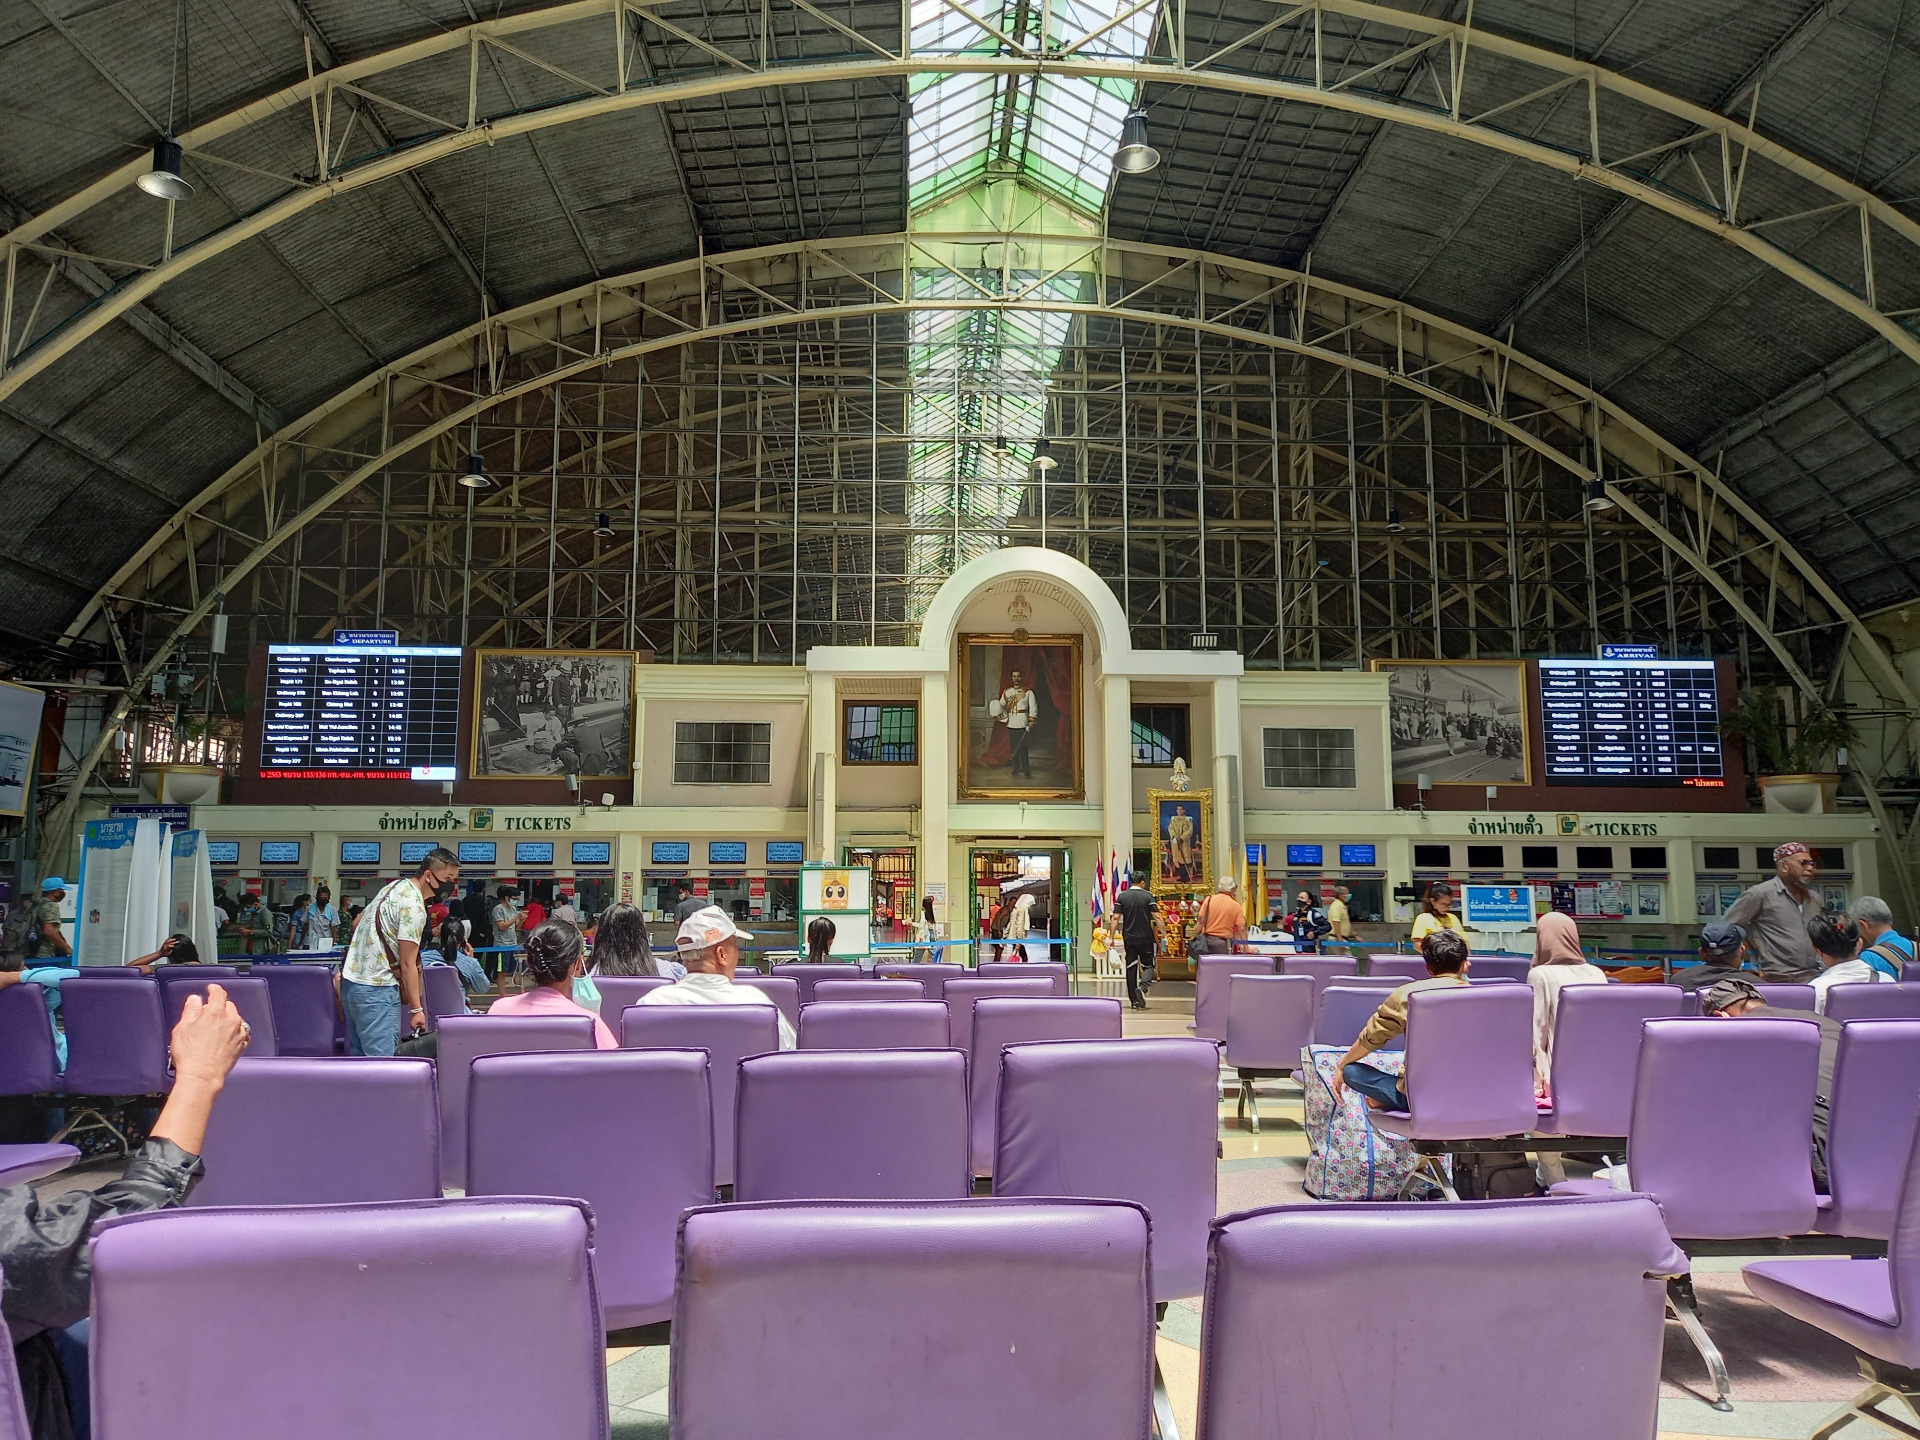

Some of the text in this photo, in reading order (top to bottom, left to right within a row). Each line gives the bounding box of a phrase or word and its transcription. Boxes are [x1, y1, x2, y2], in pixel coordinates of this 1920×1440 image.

[378, 810, 458, 830] จำหน่ายตั๋ว
[504, 817, 572, 831] TICKETS
[1468, 813, 1543, 835] จำหน่ายตั๋ว
[1594, 823, 1658, 836] TICKETS
